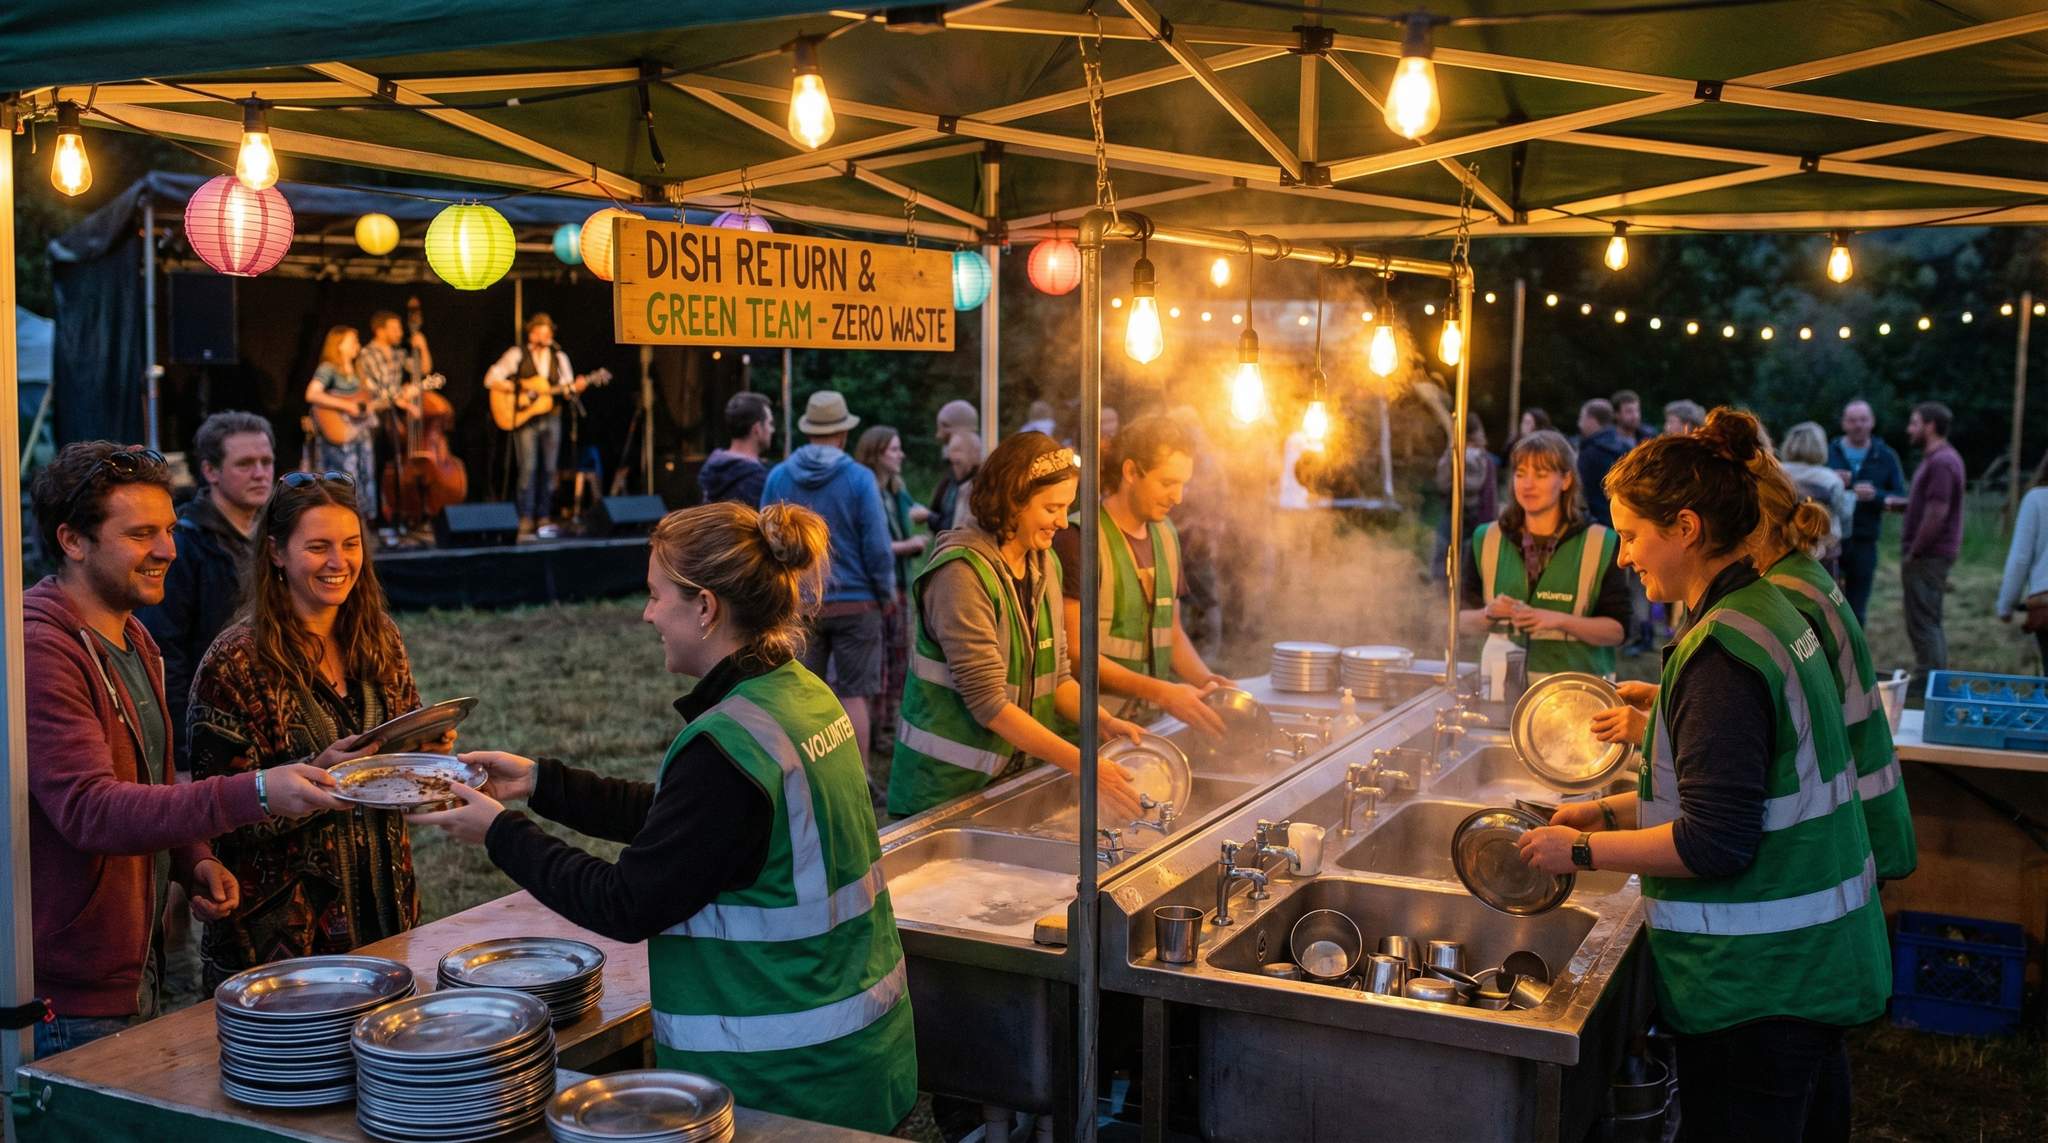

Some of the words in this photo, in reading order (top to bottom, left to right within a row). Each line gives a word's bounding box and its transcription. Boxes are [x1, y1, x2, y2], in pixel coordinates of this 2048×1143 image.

[646, 229, 721, 283] DISH
[736, 238, 847, 291] RETURN
[858, 249, 876, 292] &
[647, 291, 737, 336] GREEN
[745, 297, 812, 340] TEAM
[831, 303, 884, 342] ZERO
[889, 306, 947, 343] WASTE
